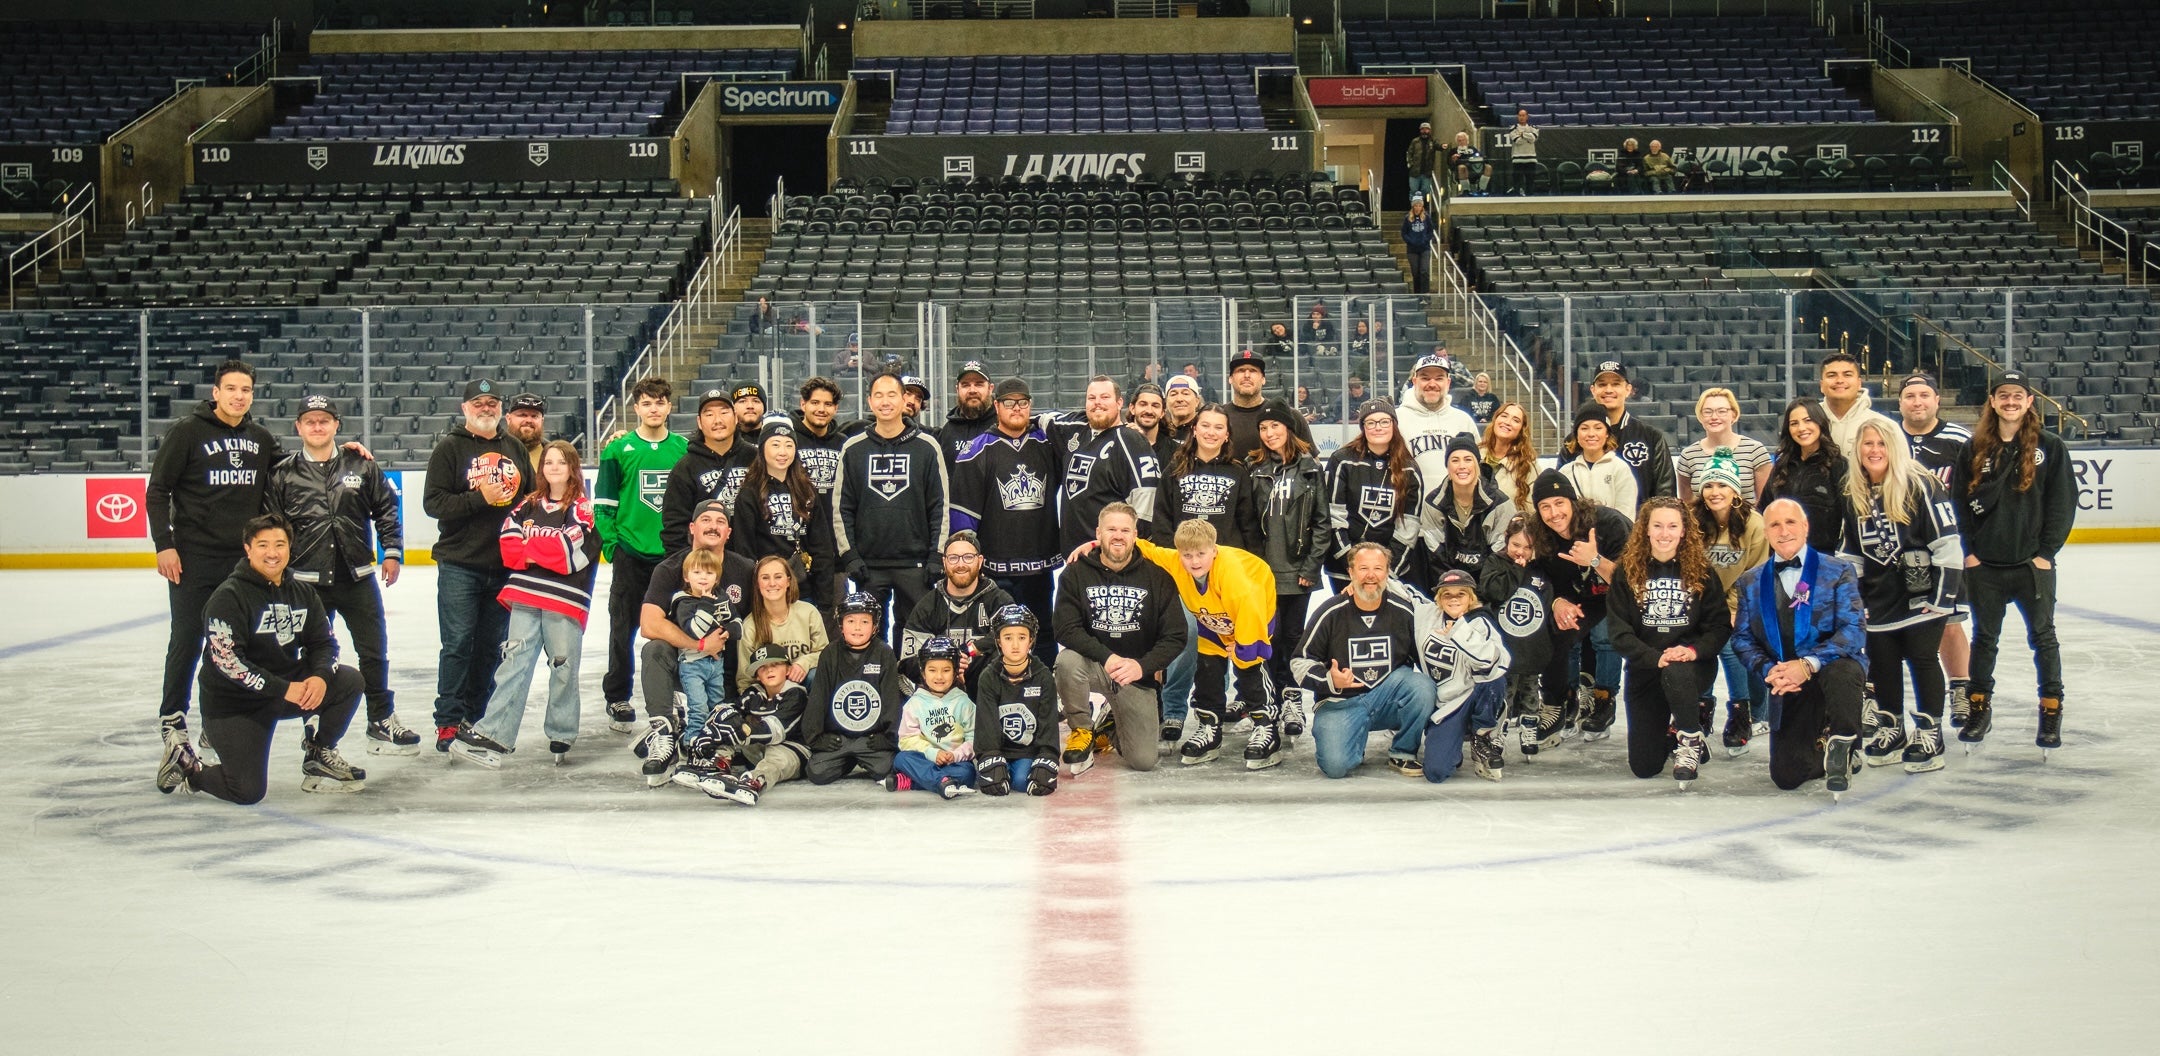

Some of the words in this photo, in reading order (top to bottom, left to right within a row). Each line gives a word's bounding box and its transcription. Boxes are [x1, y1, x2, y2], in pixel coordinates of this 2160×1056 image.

[724, 86, 830, 112] Spectrum
[1341, 85, 1396, 100] boldyn
[1911, 129, 1940, 143] 112
[2054, 126, 2085, 140] 113
[1271, 136, 1299, 150] 111
[1494, 133, 1513, 148] 11
[202, 148, 231, 162] 110
[629, 143, 658, 157] 110
[850, 141, 877, 155] 111
[1820, 147, 1845, 159] LA
[52, 148, 83, 163] 109
[373, 145, 402, 166] LA
[402, 144, 467, 169] KINGS
[1178, 156, 1202, 167] LA
[947, 160, 971, 171] LA
[1003, 154, 1045, 183] LA
[1047, 153, 1146, 183] KINGS
[1696, 145, 1789, 182] KINGS
[4, 166, 30, 178] LA
[204, 440, 221, 456] LA
[226, 438, 260, 455] KINGS
[1099, 440, 1115, 460] C
[798, 449, 841, 460] HOCKEY
[472, 457, 490, 467] Stan
[806, 458, 838, 467] NIGHT
[872, 459, 906, 473] LA
[1070, 458, 1092, 475] LA
[209, 470, 258, 485] HOCKEY
[1179, 475, 1235, 487] HOCKEY
[1186, 482, 1226, 494] NIGHT
[1363, 490, 1394, 507] LA
[984, 558, 1007, 572] LOS
[1010, 553, 1063, 573] ANGELES
[1706, 550, 1739, 563] INGS
[1086, 586, 1148, 599] HOCKEY
[1643, 589, 1686, 601] NIGHT
[1097, 598, 1137, 609] NIGHT
[1512, 603, 1530, 614] LA
[978, 602, 990, 627] A
[904, 636, 915, 656] 3
[1352, 642, 1389, 660] LA
[1424, 640, 1457, 663] LA
[849, 697, 866, 707] LA
[928, 707, 949, 717] MINOR
[925, 714, 956, 726] PENALTY
[1005, 718, 1022, 729] LA
